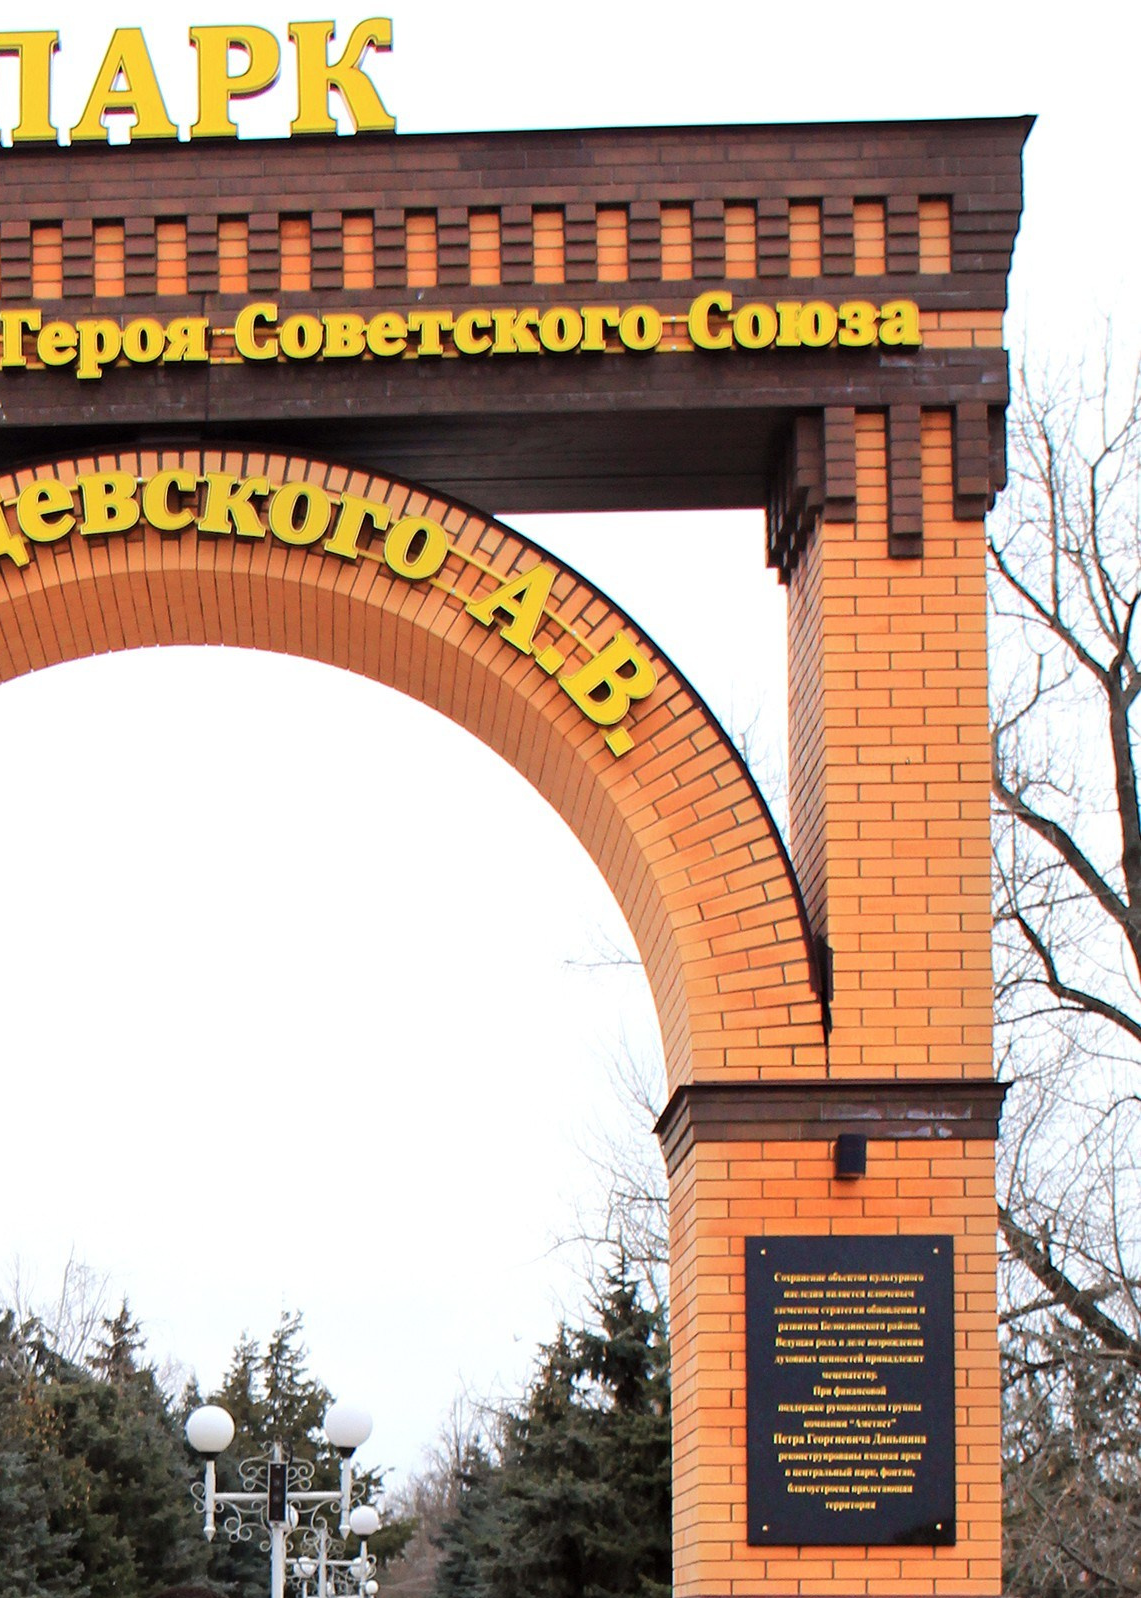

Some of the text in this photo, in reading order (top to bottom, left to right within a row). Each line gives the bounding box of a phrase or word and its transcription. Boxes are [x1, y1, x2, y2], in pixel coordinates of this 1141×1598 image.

[0, 308, 210, 380] Героя
[234, 301, 663, 363] Советского
[687, 290, 923, 352] Союза
[774, 1433, 805, 1446] Петра
[807, 1433, 870, 1446] Георгиевича
